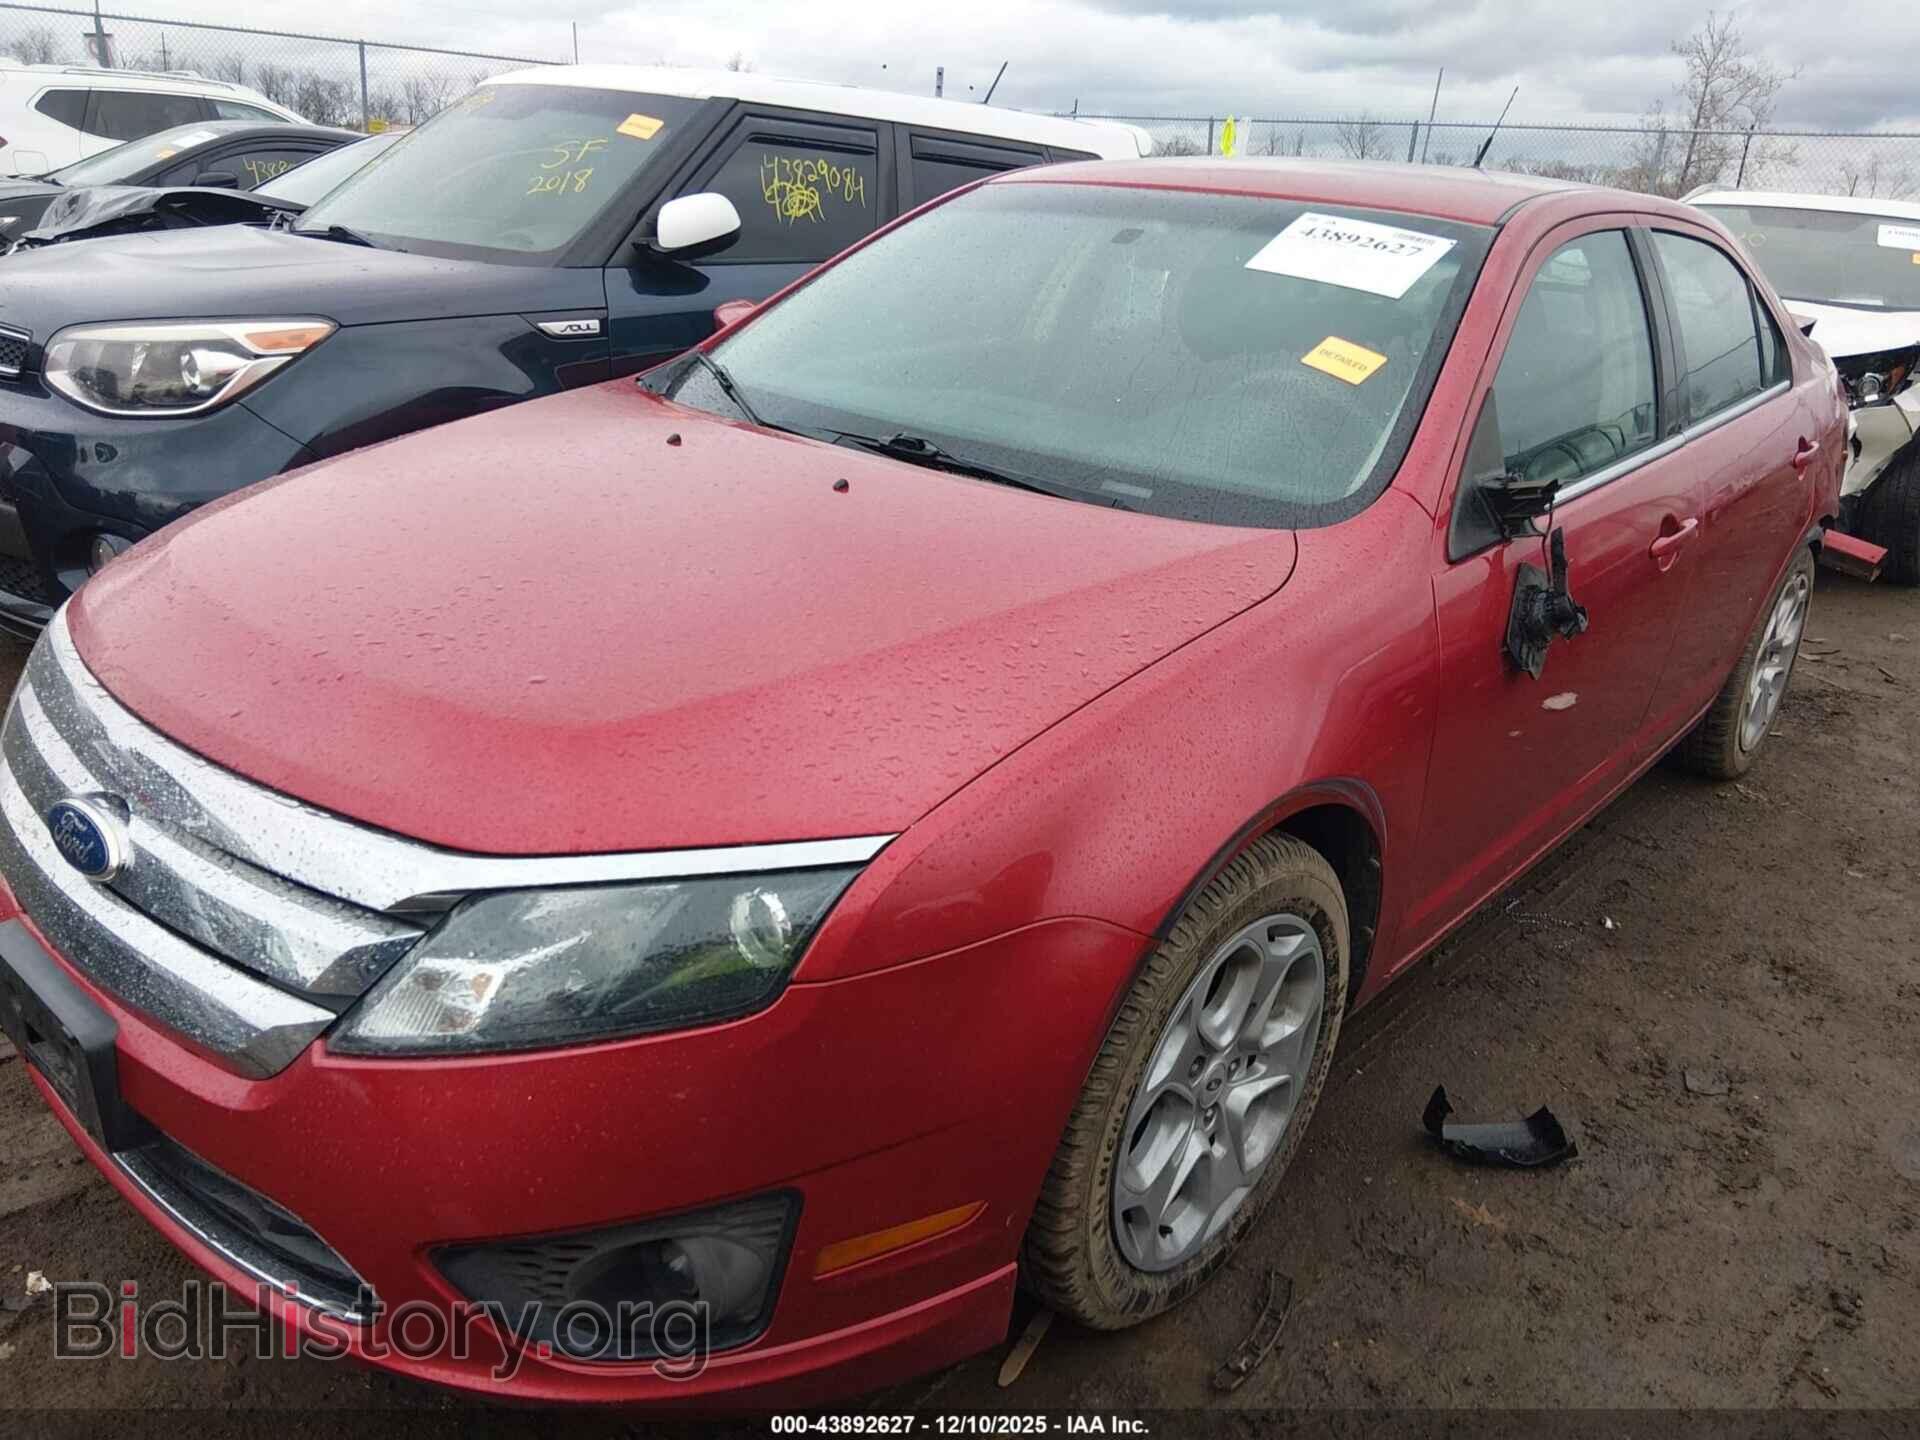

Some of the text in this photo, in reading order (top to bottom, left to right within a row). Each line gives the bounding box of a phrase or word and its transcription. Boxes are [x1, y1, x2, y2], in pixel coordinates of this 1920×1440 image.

[540, 137, 609, 169] SF
[526, 168, 594, 195] 2018
[763, 153, 866, 209] 43829084
[1299, 226, 1426, 257] 43892627
[54, 811, 95, 864] Ford
